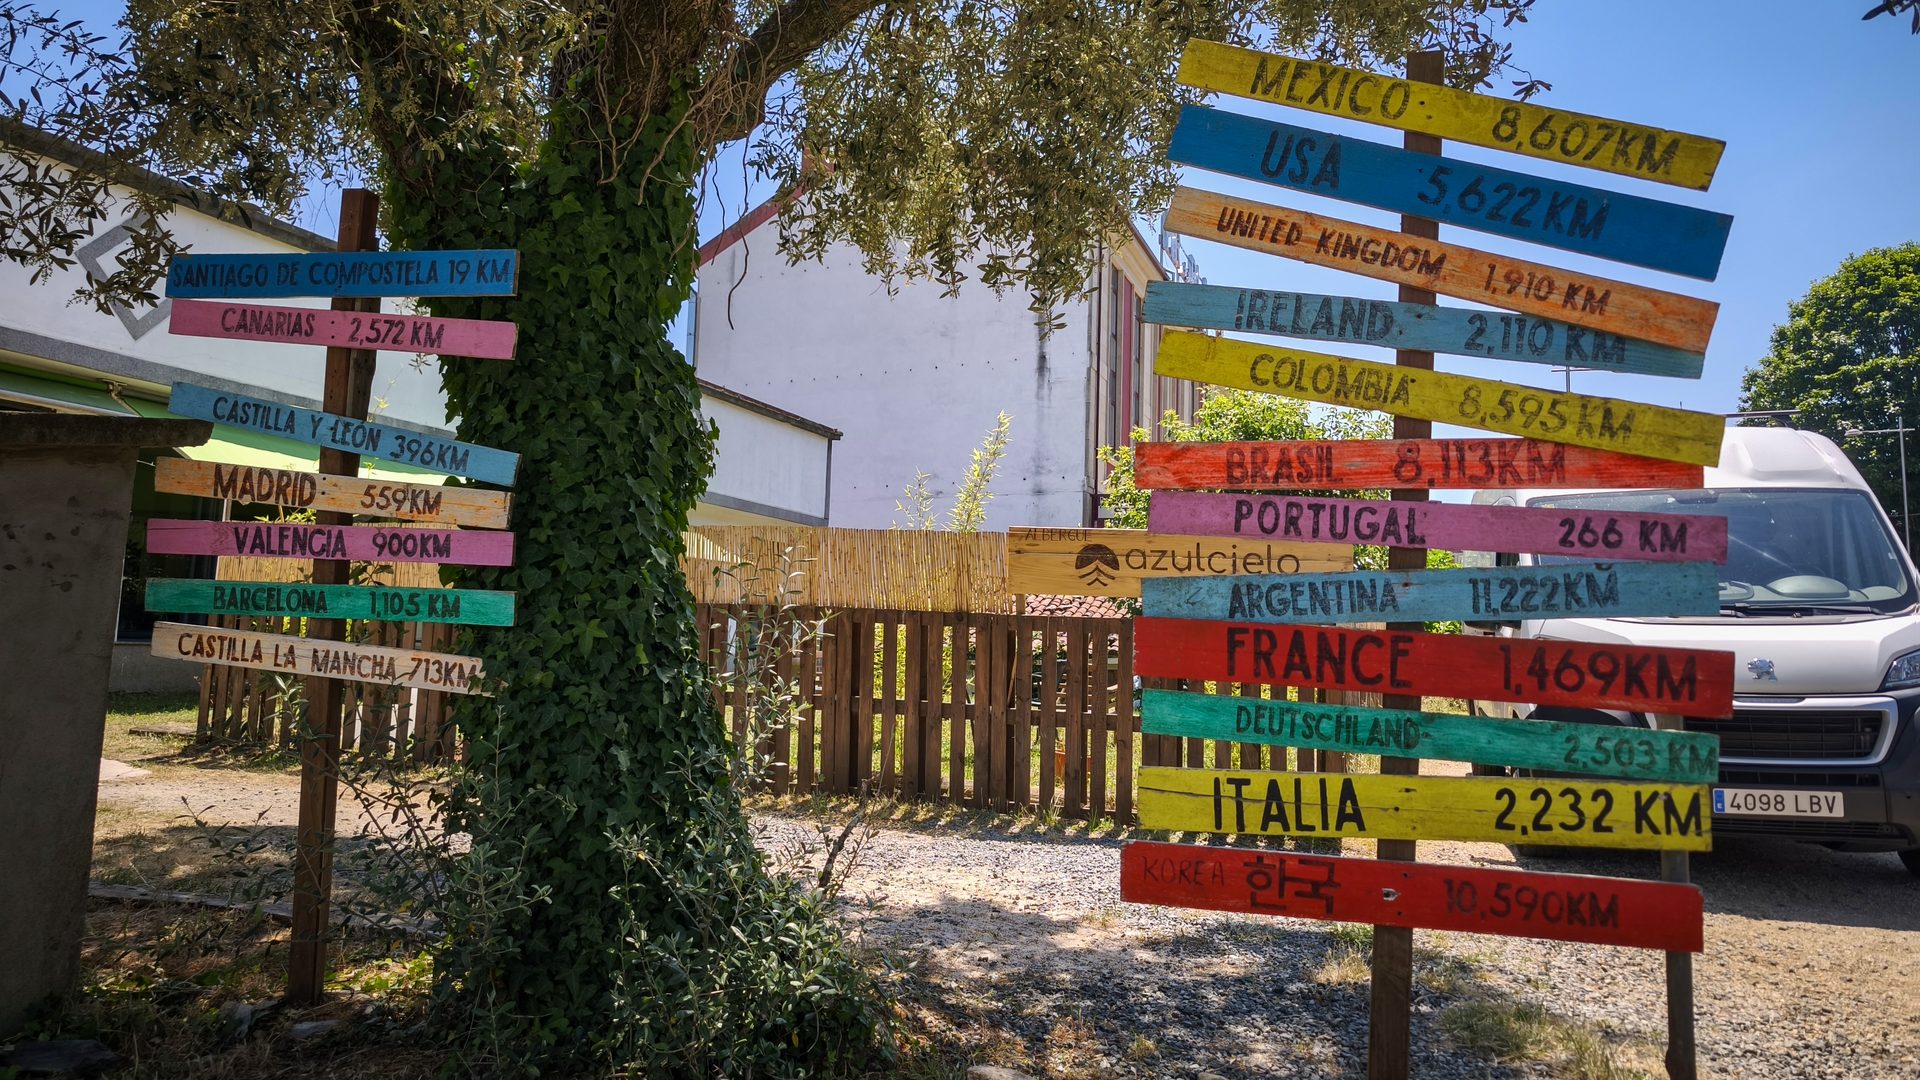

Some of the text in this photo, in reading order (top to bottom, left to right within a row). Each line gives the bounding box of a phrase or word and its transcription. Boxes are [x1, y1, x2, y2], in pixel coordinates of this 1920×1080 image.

[1250, 56, 1410, 120] MEXICO
[1260, 129, 1342, 190] USA
[172, 259, 512, 288] SANTIAGO DE COMPOSTELA 19 KM
[1216, 206, 1611, 316] UNITED KINGDOM 1,910 KM
[220, 307, 315, 338] CANARIAS
[1234, 289, 1395, 341] IRELAND
[1565, 324, 1628, 365] KM
[1249, 353, 1411, 406] COLOMBIA
[211, 396, 296, 434] CASTILLA
[310, 414, 329, 439] Y
[212, 465, 317, 508] MADRID
[1225, 445, 1344, 486] BRASIL
[233, 526, 347, 559] VALENCIA
[1233, 499, 1688, 554] PORTUGAL 266 KM
[1125, 542, 1301, 576] azulcielo
[212, 586, 328, 614] BARCELONA
[427, 593, 461, 619] KM
[1228, 578, 1401, 619] ARGENTINA
[178, 633, 263, 665] CASTILLA
[273, 644, 297, 670] LA
[311, 647, 397, 681] MANCHA
[1227, 627, 1414, 689] FRANCE
[1235, 704, 1421, 750] DEUTSCHLAND
[1666, 742, 1717, 776] KM
[1213, 776, 1705, 838] ITALIA 2,232 KM
[1730, 793, 1836, 813] 4098 LBV
[1141, 856, 1225, 887] KOREA
